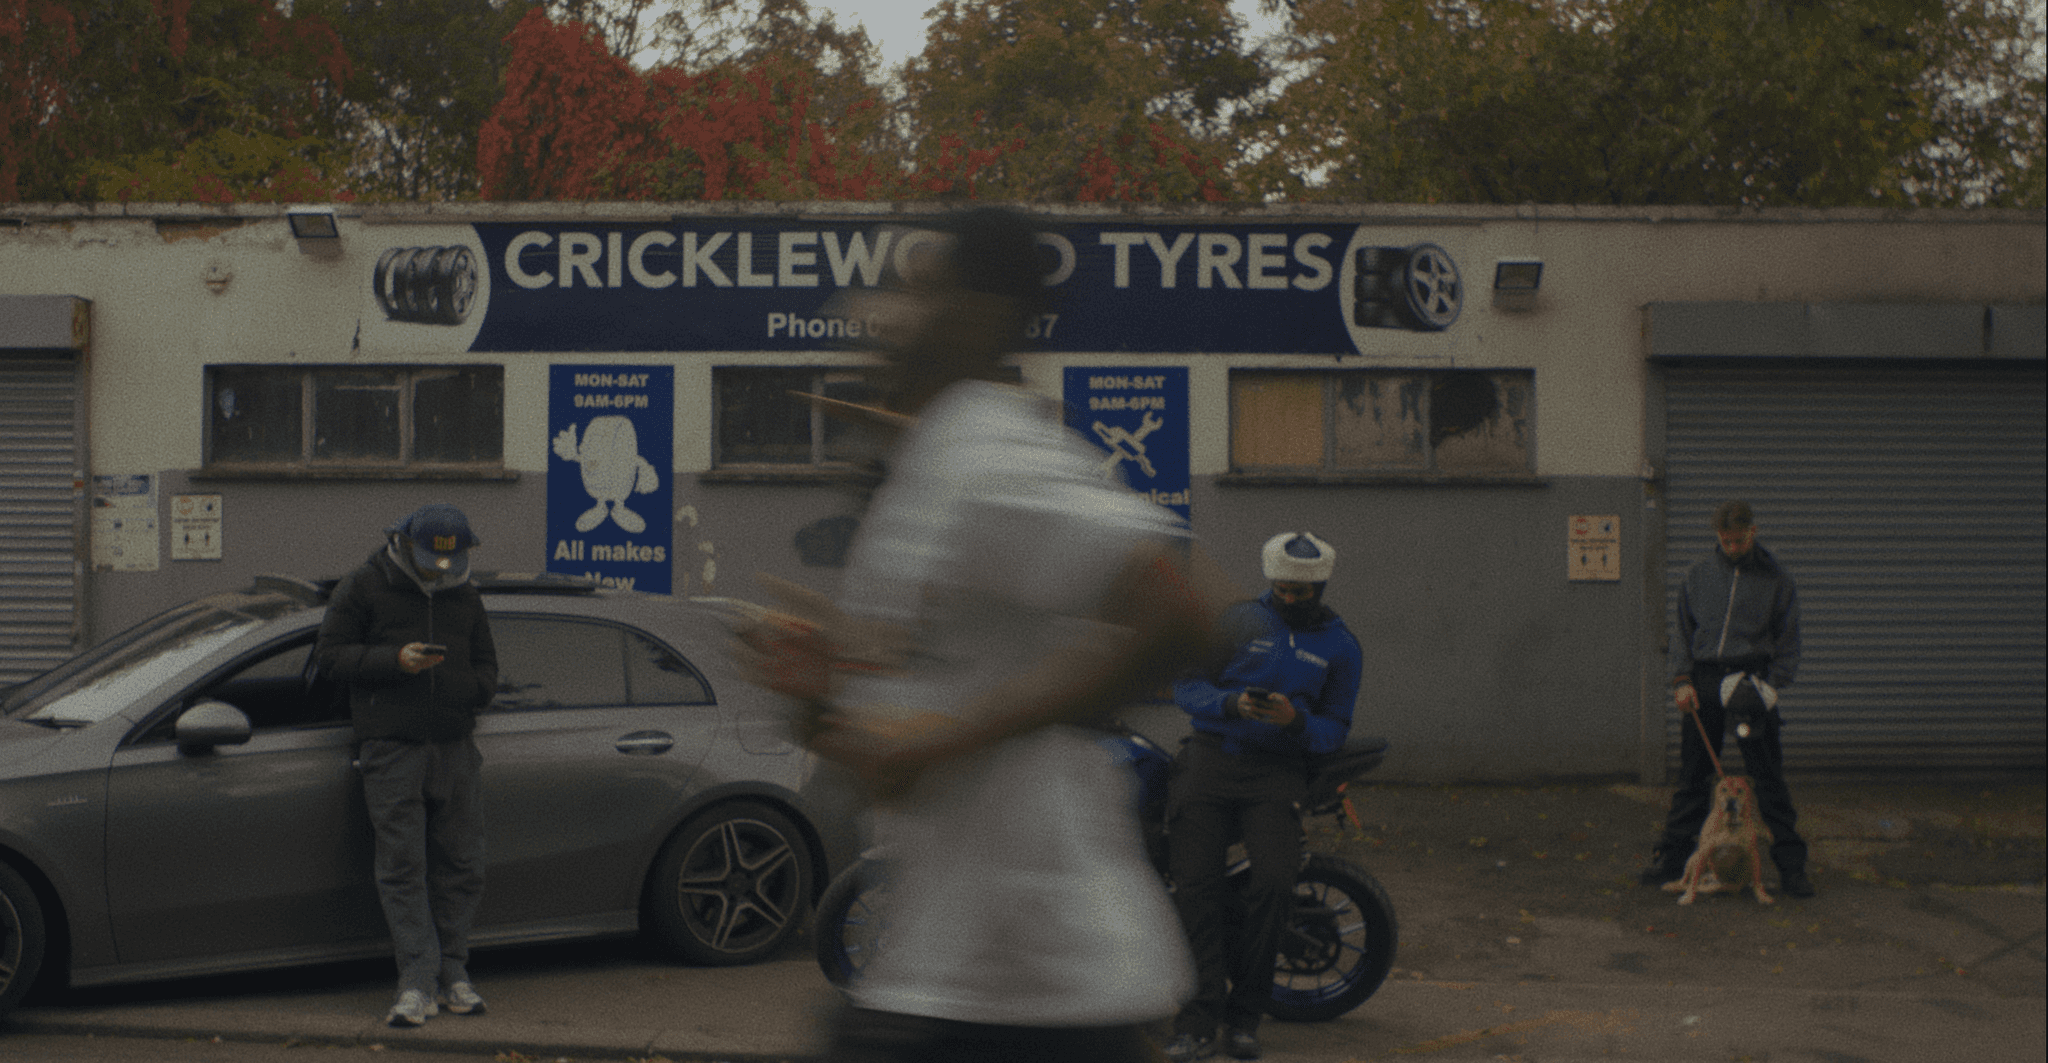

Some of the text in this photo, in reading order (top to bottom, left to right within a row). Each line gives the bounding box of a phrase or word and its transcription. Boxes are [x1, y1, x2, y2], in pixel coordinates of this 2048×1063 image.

[504, 230, 1334, 291] CRICKLEWOD TYRES
[574, 373, 649, 388] MON-SAT
[1089, 375, 1167, 390] MON-SAT
[573, 394, 649, 409] 9AM-6PM
[1089, 396, 1166, 410] 9AM-6PM
[1138, 487, 1190, 505] nical
[553, 539, 667, 562] All makes
